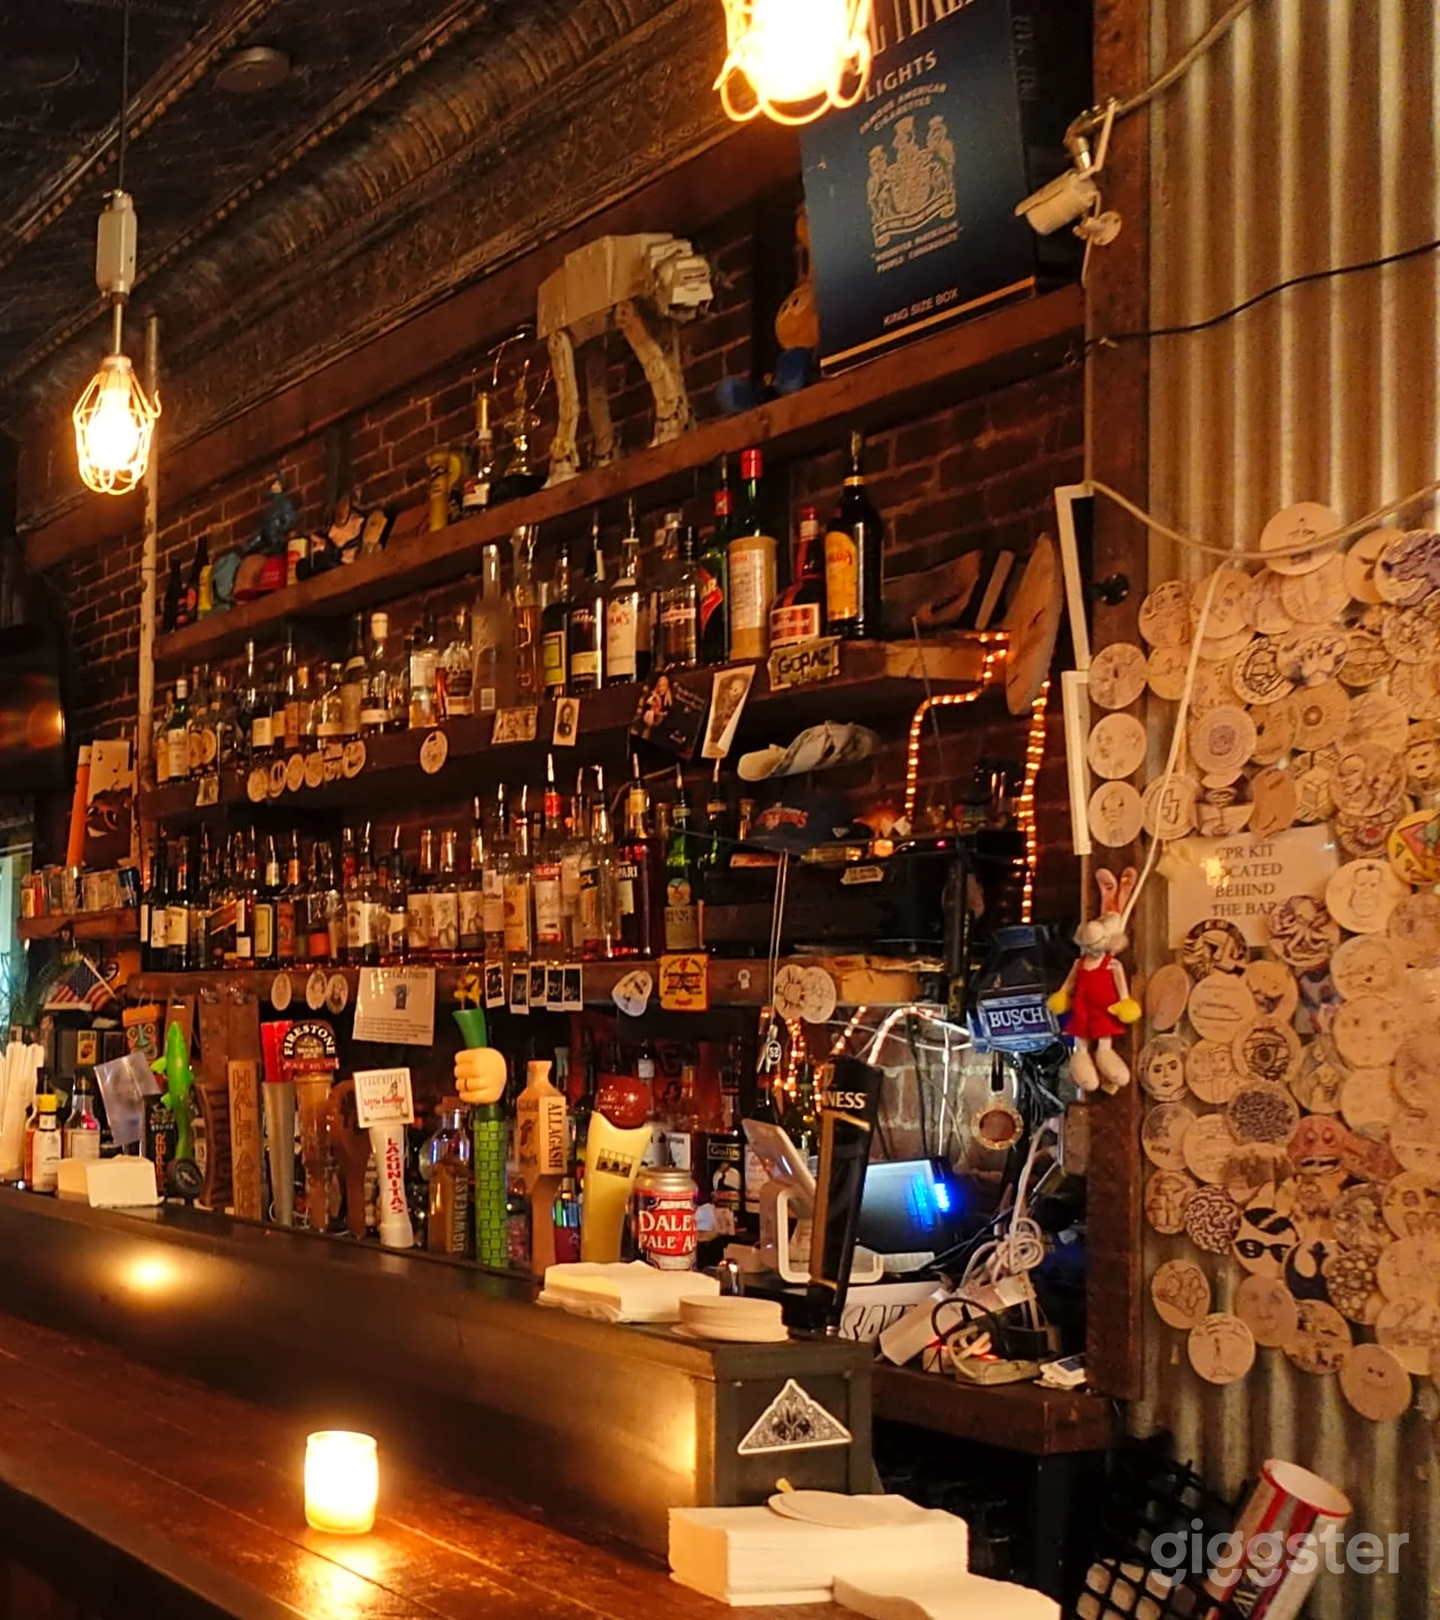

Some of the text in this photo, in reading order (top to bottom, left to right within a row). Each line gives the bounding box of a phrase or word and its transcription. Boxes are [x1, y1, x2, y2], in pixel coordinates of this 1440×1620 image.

[864, 49, 937, 103] LIGHTS
[883, 287, 959, 327] KING SIZE BOX
[1213, 843, 1276, 860] CPR KIT
[1212, 862, 1283, 879] OCATED
[1215, 882, 1277, 899] BEHIND
[1211, 903, 1243, 917] THE
[988, 1007, 1047, 1028] BUSCH
[283, 1023, 336, 1056] FIRESTONE
[233, 1069, 252, 1147] HALF
[547, 1102, 564, 1169] ALLAGASH
[385, 1137, 405, 1214] LAGUNITAS
[454, 1175, 468, 1253] DOWNEAST
[638, 1233, 696, 1252] PALE AL
